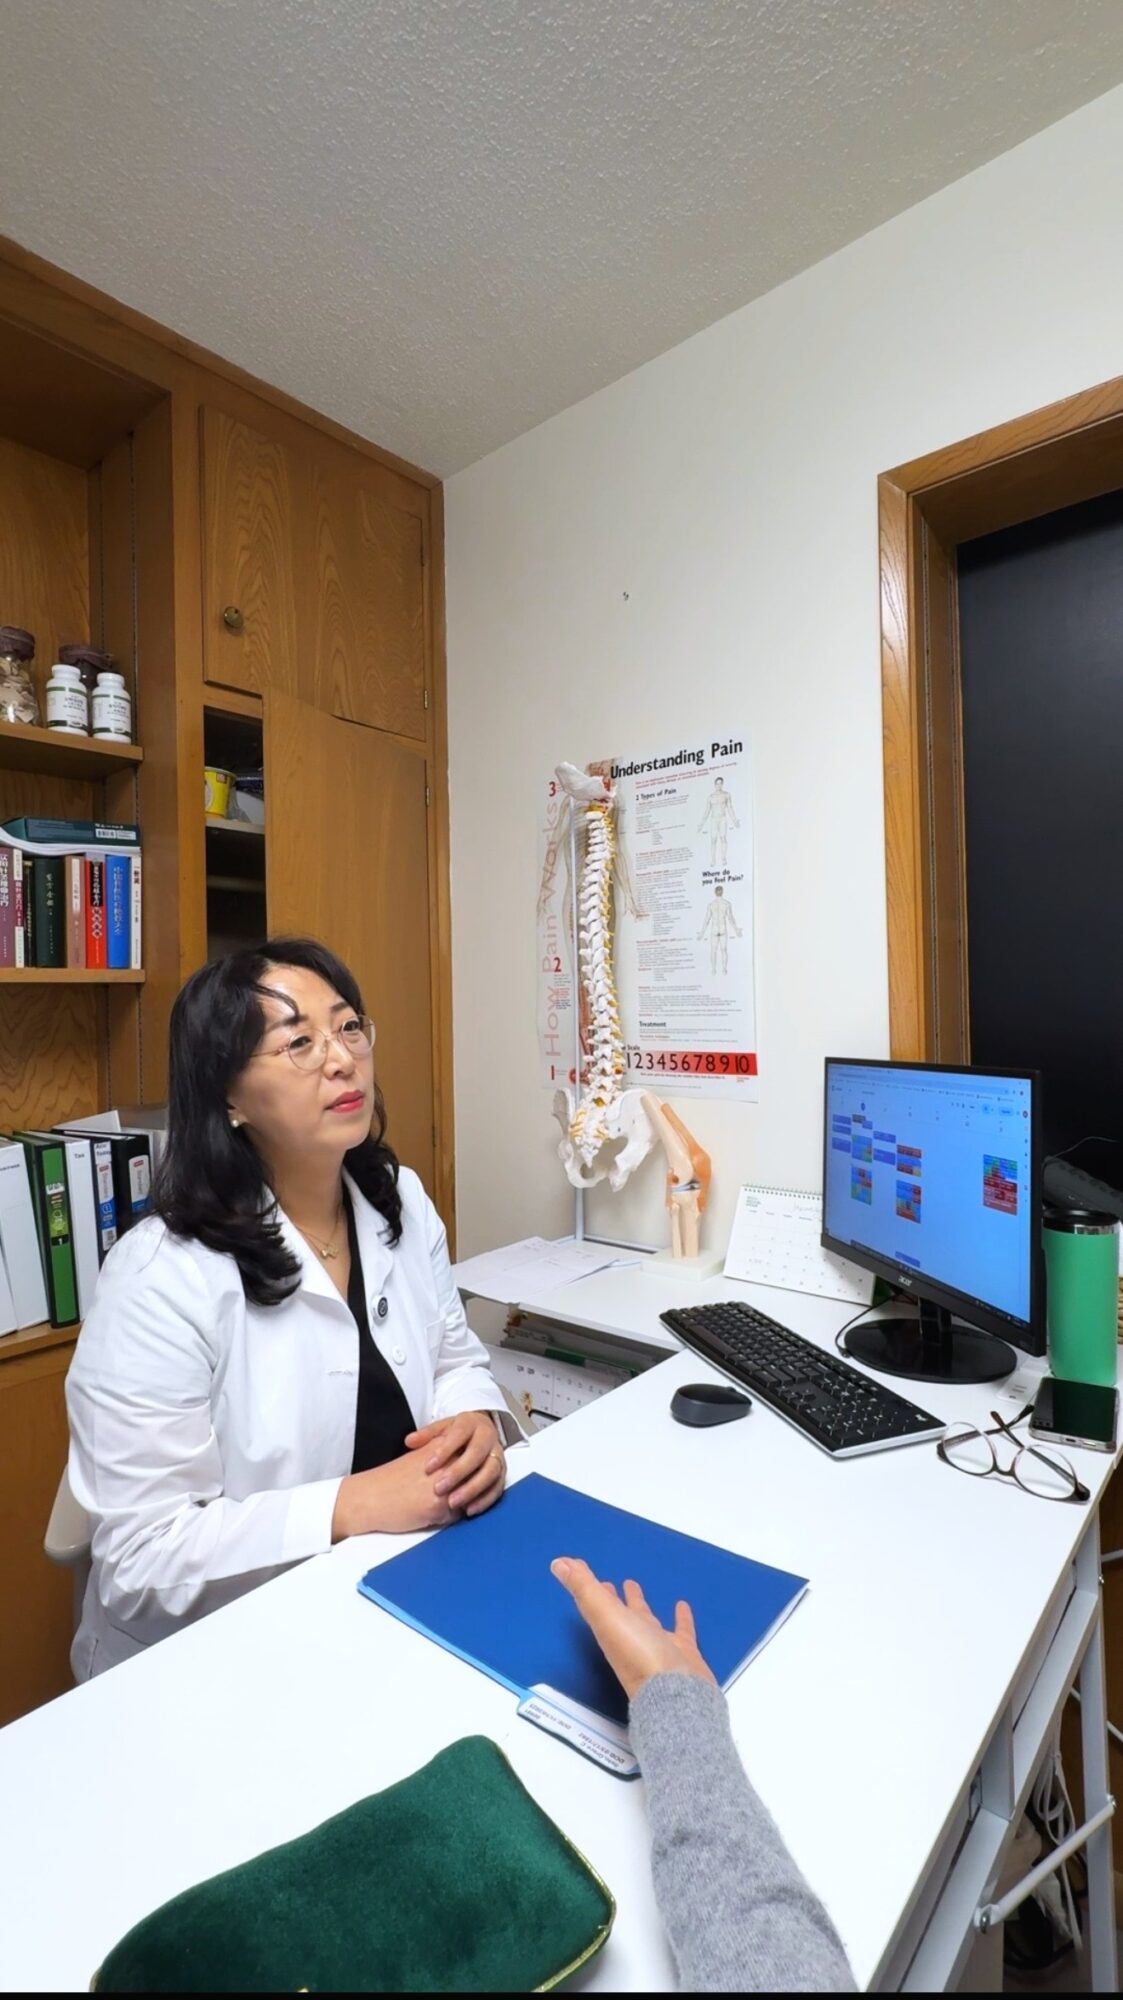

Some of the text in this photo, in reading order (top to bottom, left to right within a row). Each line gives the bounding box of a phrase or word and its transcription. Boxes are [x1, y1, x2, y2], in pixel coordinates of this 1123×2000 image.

[610, 749, 704, 779] Understanding
[711, 739, 743, 758] Pain
[549, 781, 556, 797] 3
[641, 792, 655, 800] Types
[664, 788, 677, 796] Pain
[554, 957, 562, 972] 2
[735, 1055, 749, 1073] 10
